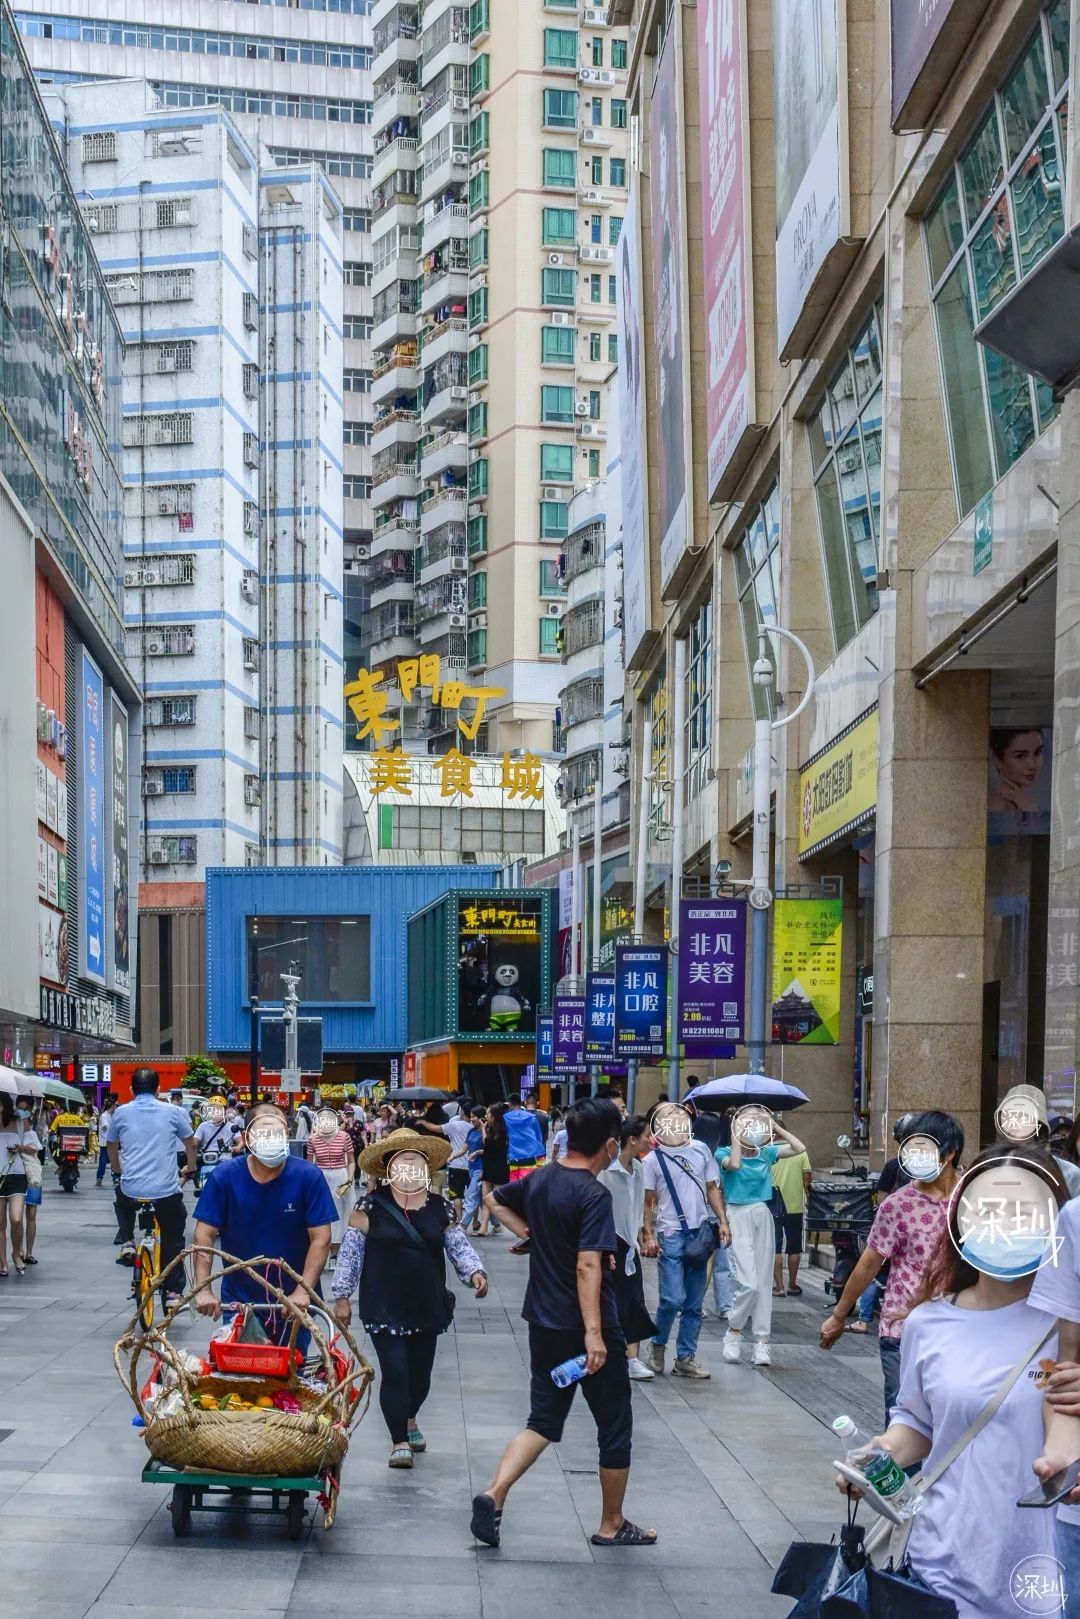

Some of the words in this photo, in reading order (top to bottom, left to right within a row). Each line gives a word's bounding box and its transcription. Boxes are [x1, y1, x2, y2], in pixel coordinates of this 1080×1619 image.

[369, 746, 544, 800] 美食城
[689, 933, 735, 955] 非凡
[624, 972, 659, 989] 非凡
[689, 962, 734, 984] 美容
[625, 994, 659, 1012] 口腔
[559, 1014, 584, 1027] 非凡
[559, 1029, 584, 1043] 美容
[1028, 1371, 1043, 1379] BIG
